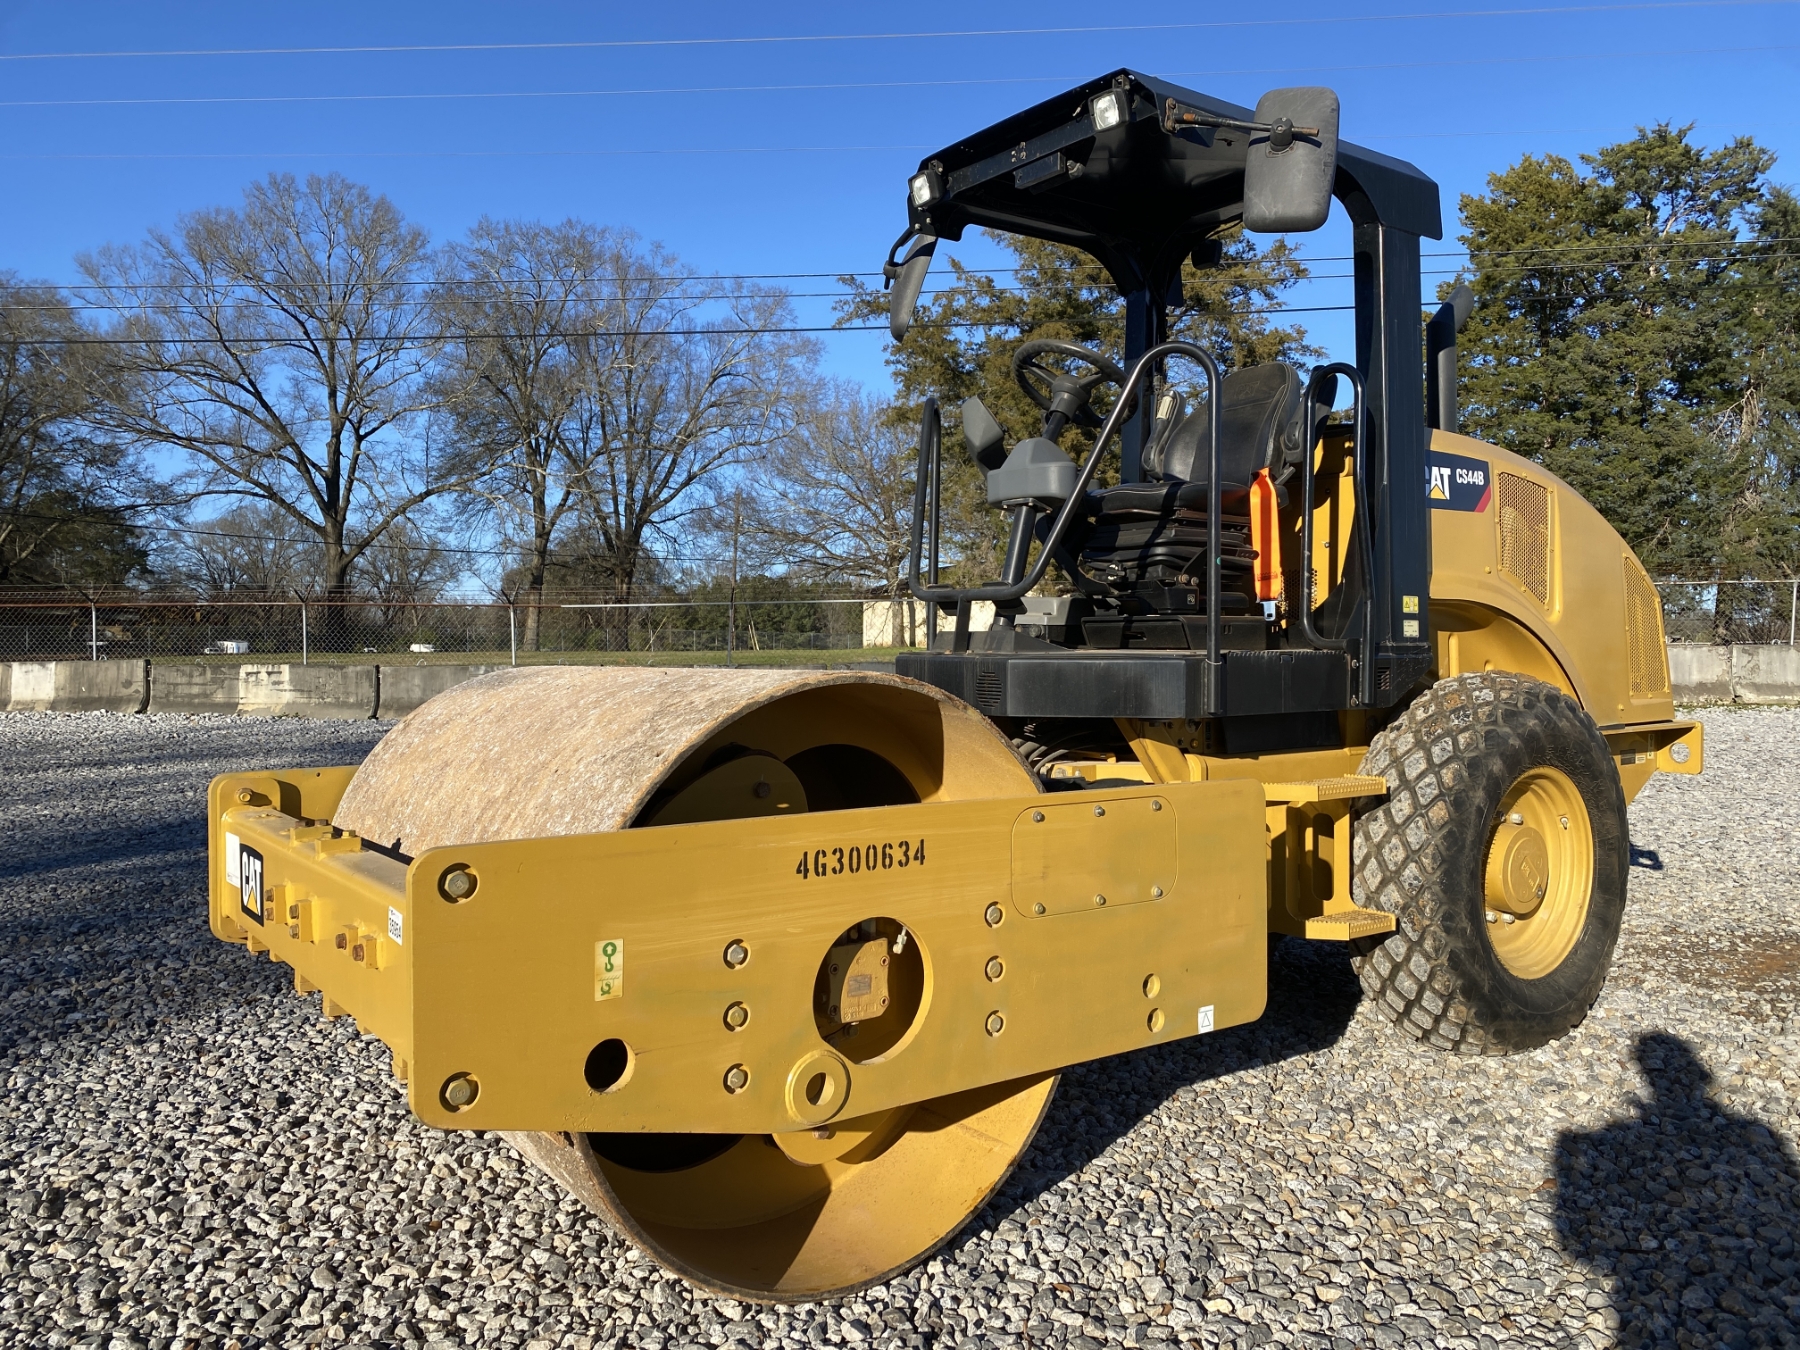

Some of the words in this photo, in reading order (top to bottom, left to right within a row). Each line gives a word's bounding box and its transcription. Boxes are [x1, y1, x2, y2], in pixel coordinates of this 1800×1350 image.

[1456, 468, 1485, 486] CS44B
[796, 838, 926, 880] 4G300634
[241, 851, 262, 916] CAT
